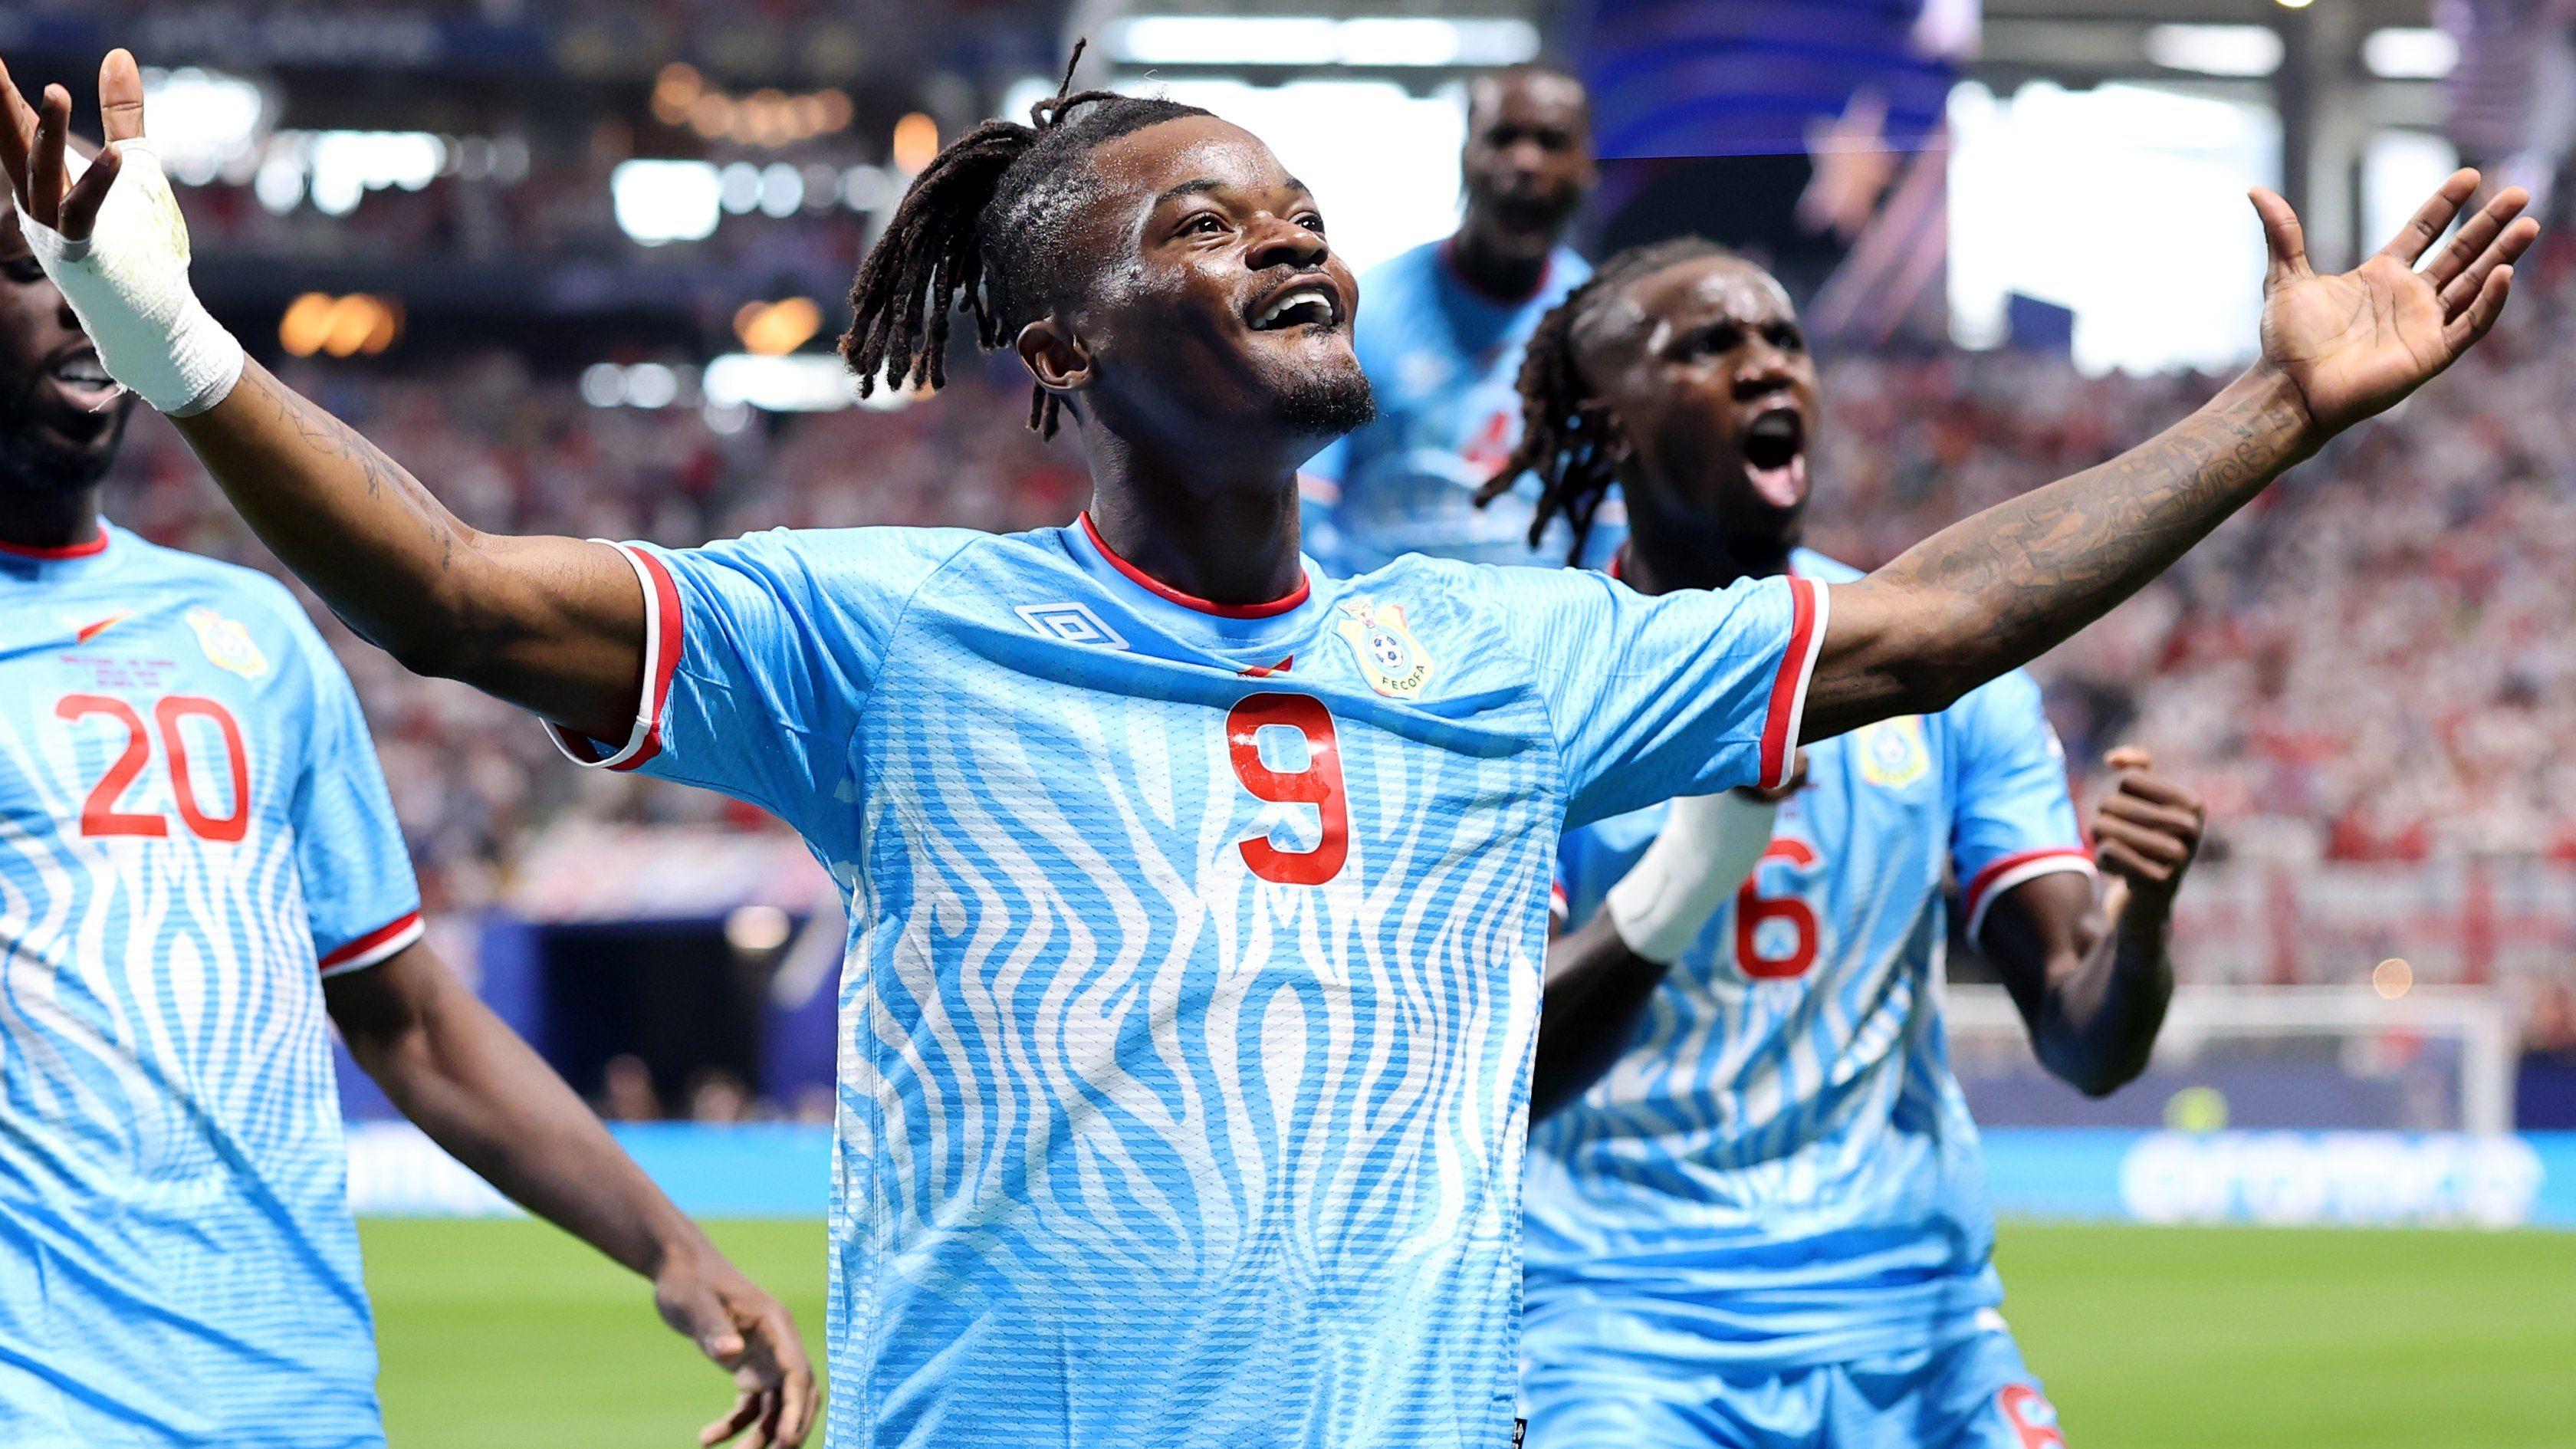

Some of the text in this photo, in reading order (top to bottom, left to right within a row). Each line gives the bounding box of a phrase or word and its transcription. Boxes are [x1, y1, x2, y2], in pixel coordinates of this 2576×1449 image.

[1382, 664, 1425, 691] FECOFA
[55, 693, 251, 845] 20
[1226, 692, 1349, 886] 9
[1736, 838, 1817, 978] 6
